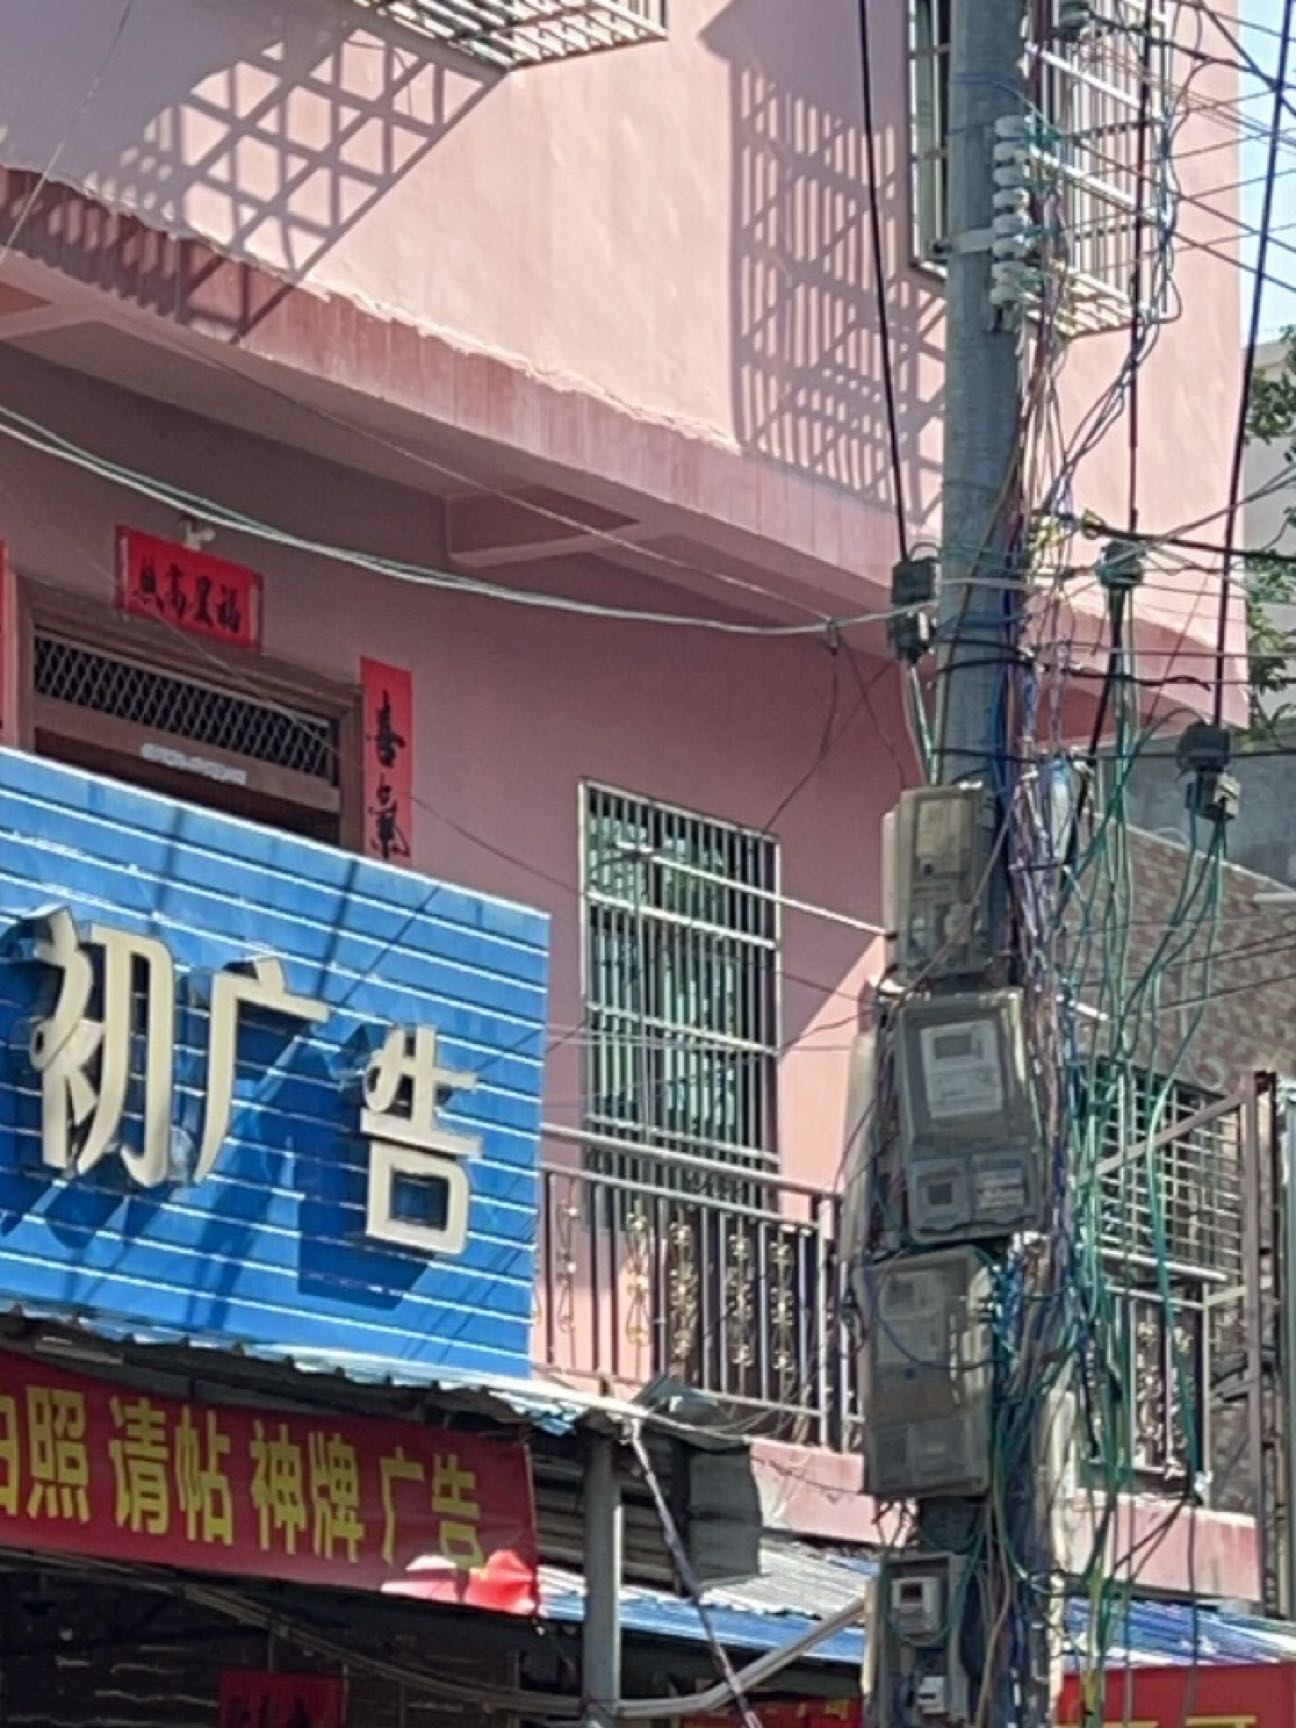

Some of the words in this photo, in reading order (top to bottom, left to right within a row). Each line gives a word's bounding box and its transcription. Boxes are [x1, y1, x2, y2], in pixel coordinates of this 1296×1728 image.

[108, 1395, 233, 1546] 请帖
[250, 1418, 366, 1564] 神牌
[379, 1445, 486, 1574] 广告
